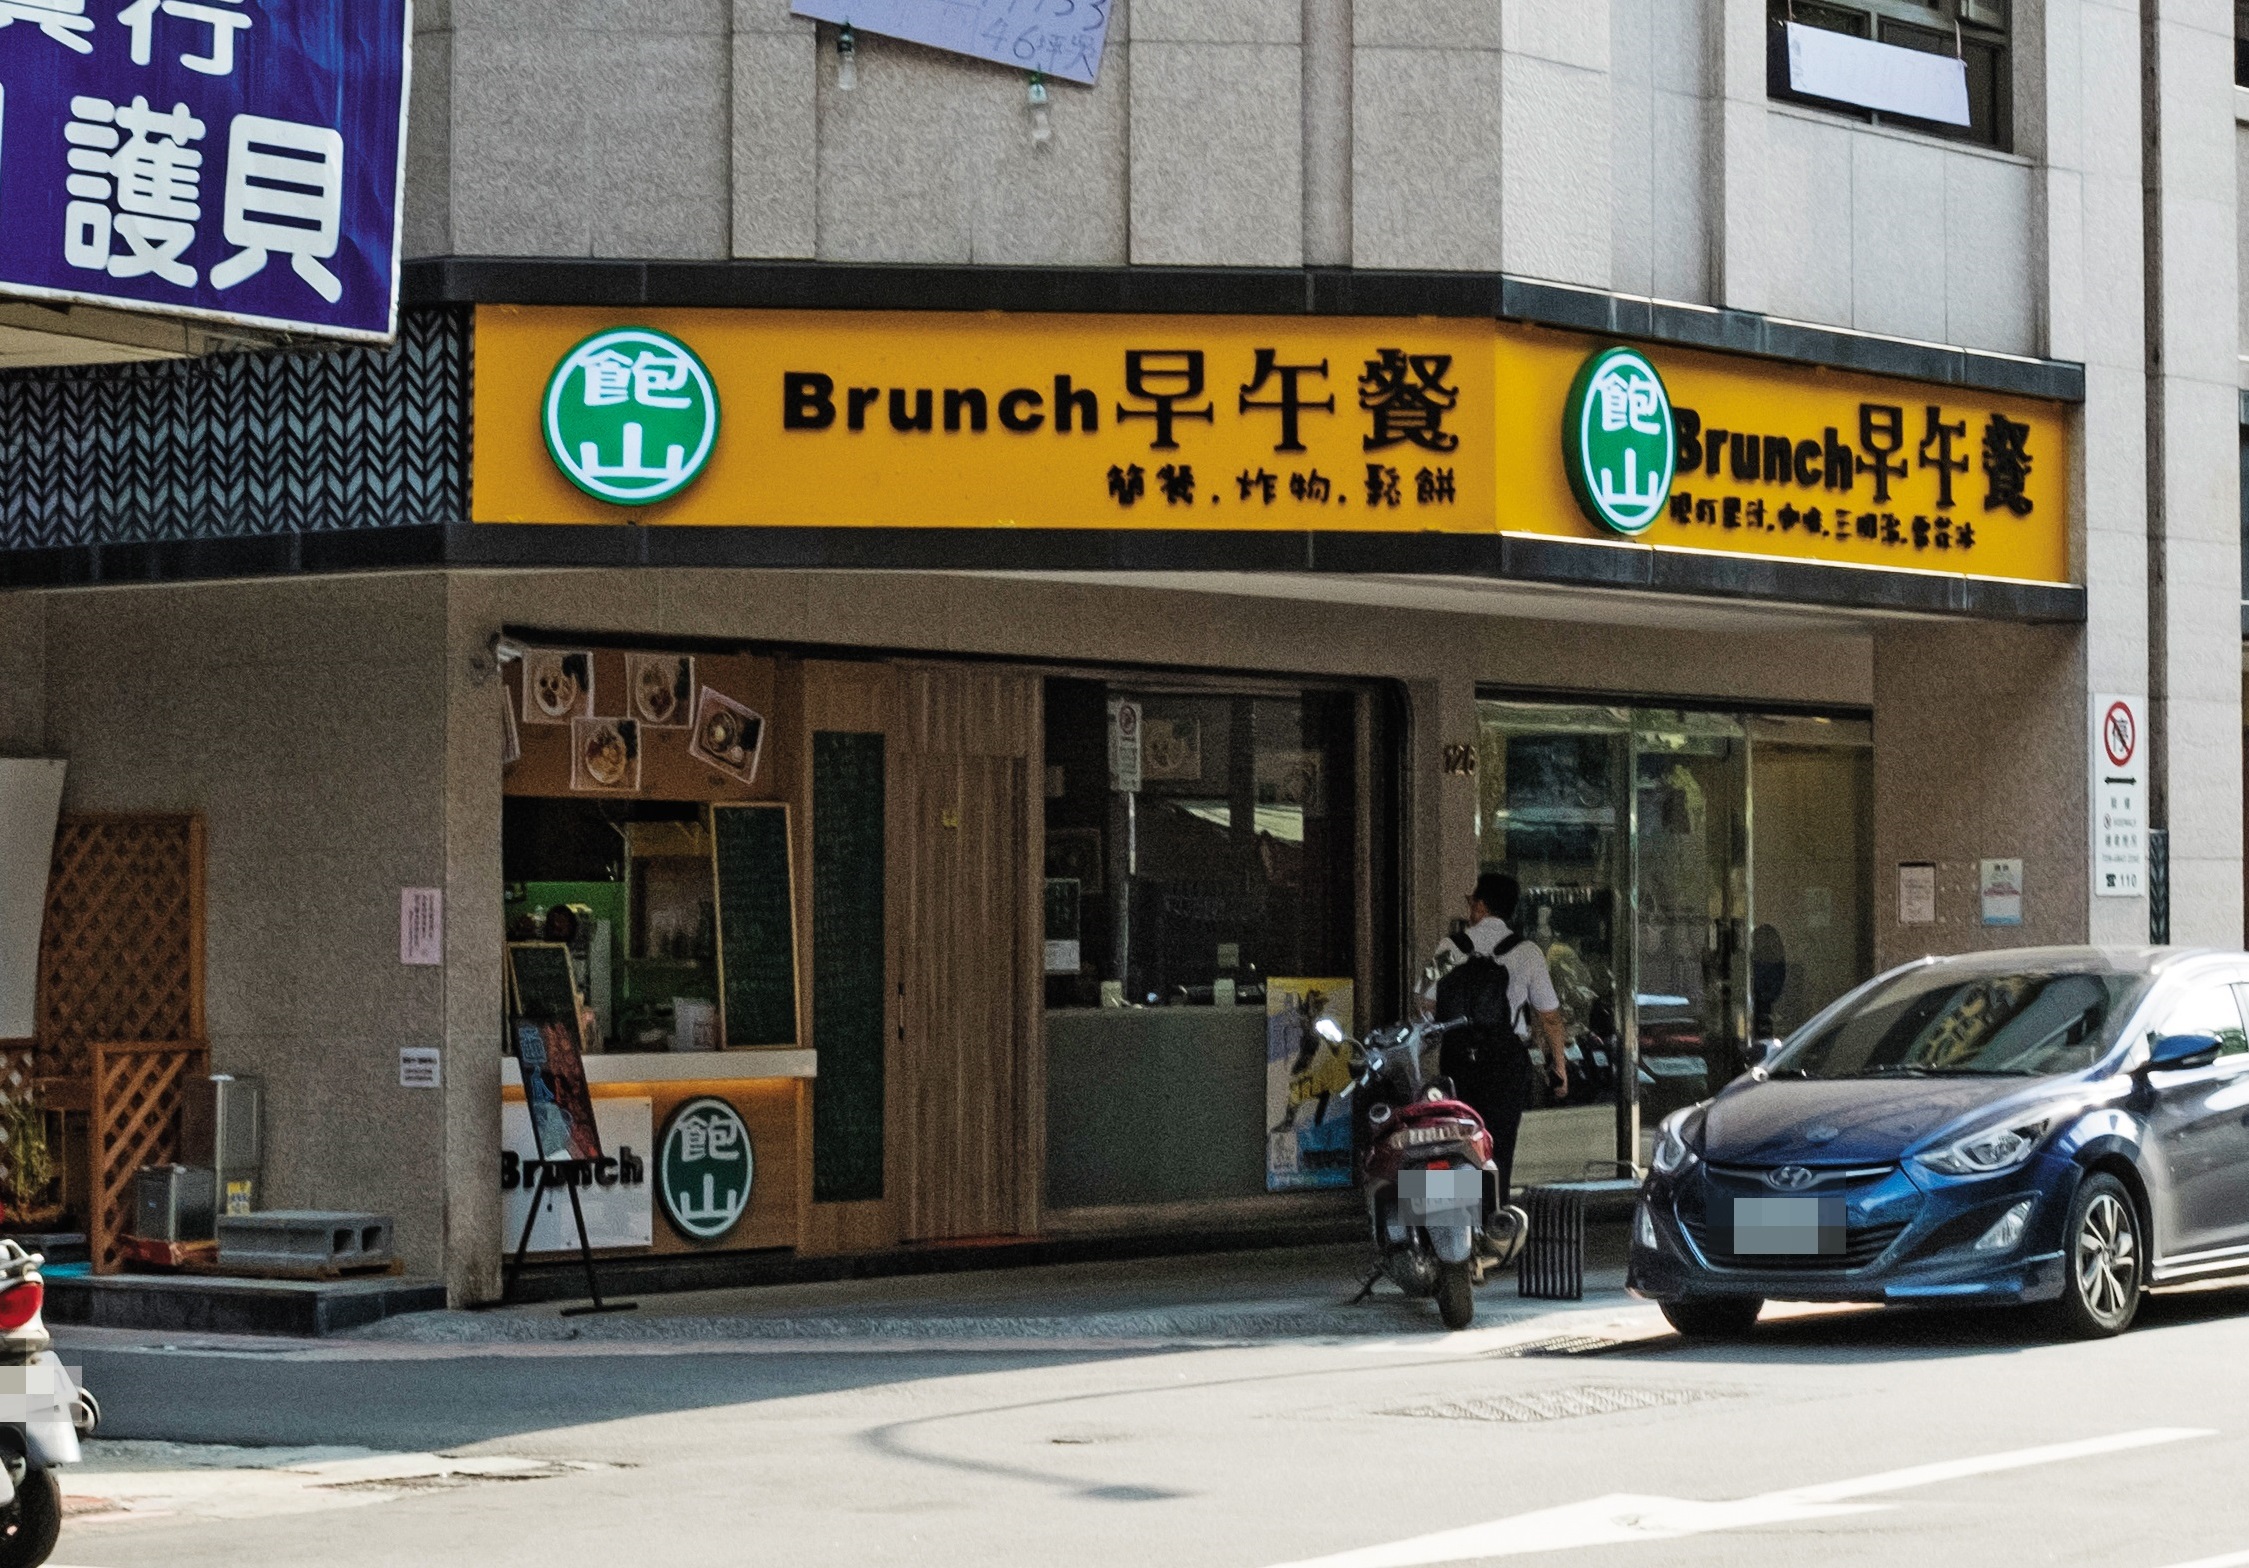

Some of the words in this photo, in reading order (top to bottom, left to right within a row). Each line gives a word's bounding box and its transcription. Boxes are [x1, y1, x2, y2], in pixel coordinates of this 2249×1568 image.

[0, 82, 344, 304] 護貝
[576, 349, 693, 478] 飽山
[783, 371, 1099, 433] Brunch
[1116, 348, 1460, 453] 早午餐
[1600, 373, 1661, 506] 飽山
[1672, 407, 1853, 491] Brunch
[1855, 403, 2034, 518] 早午餐
[2119, 873, 2138, 888] 110
[501, 1146, 644, 1189] Brunch
[677, 1115, 740, 1219] 飽山
